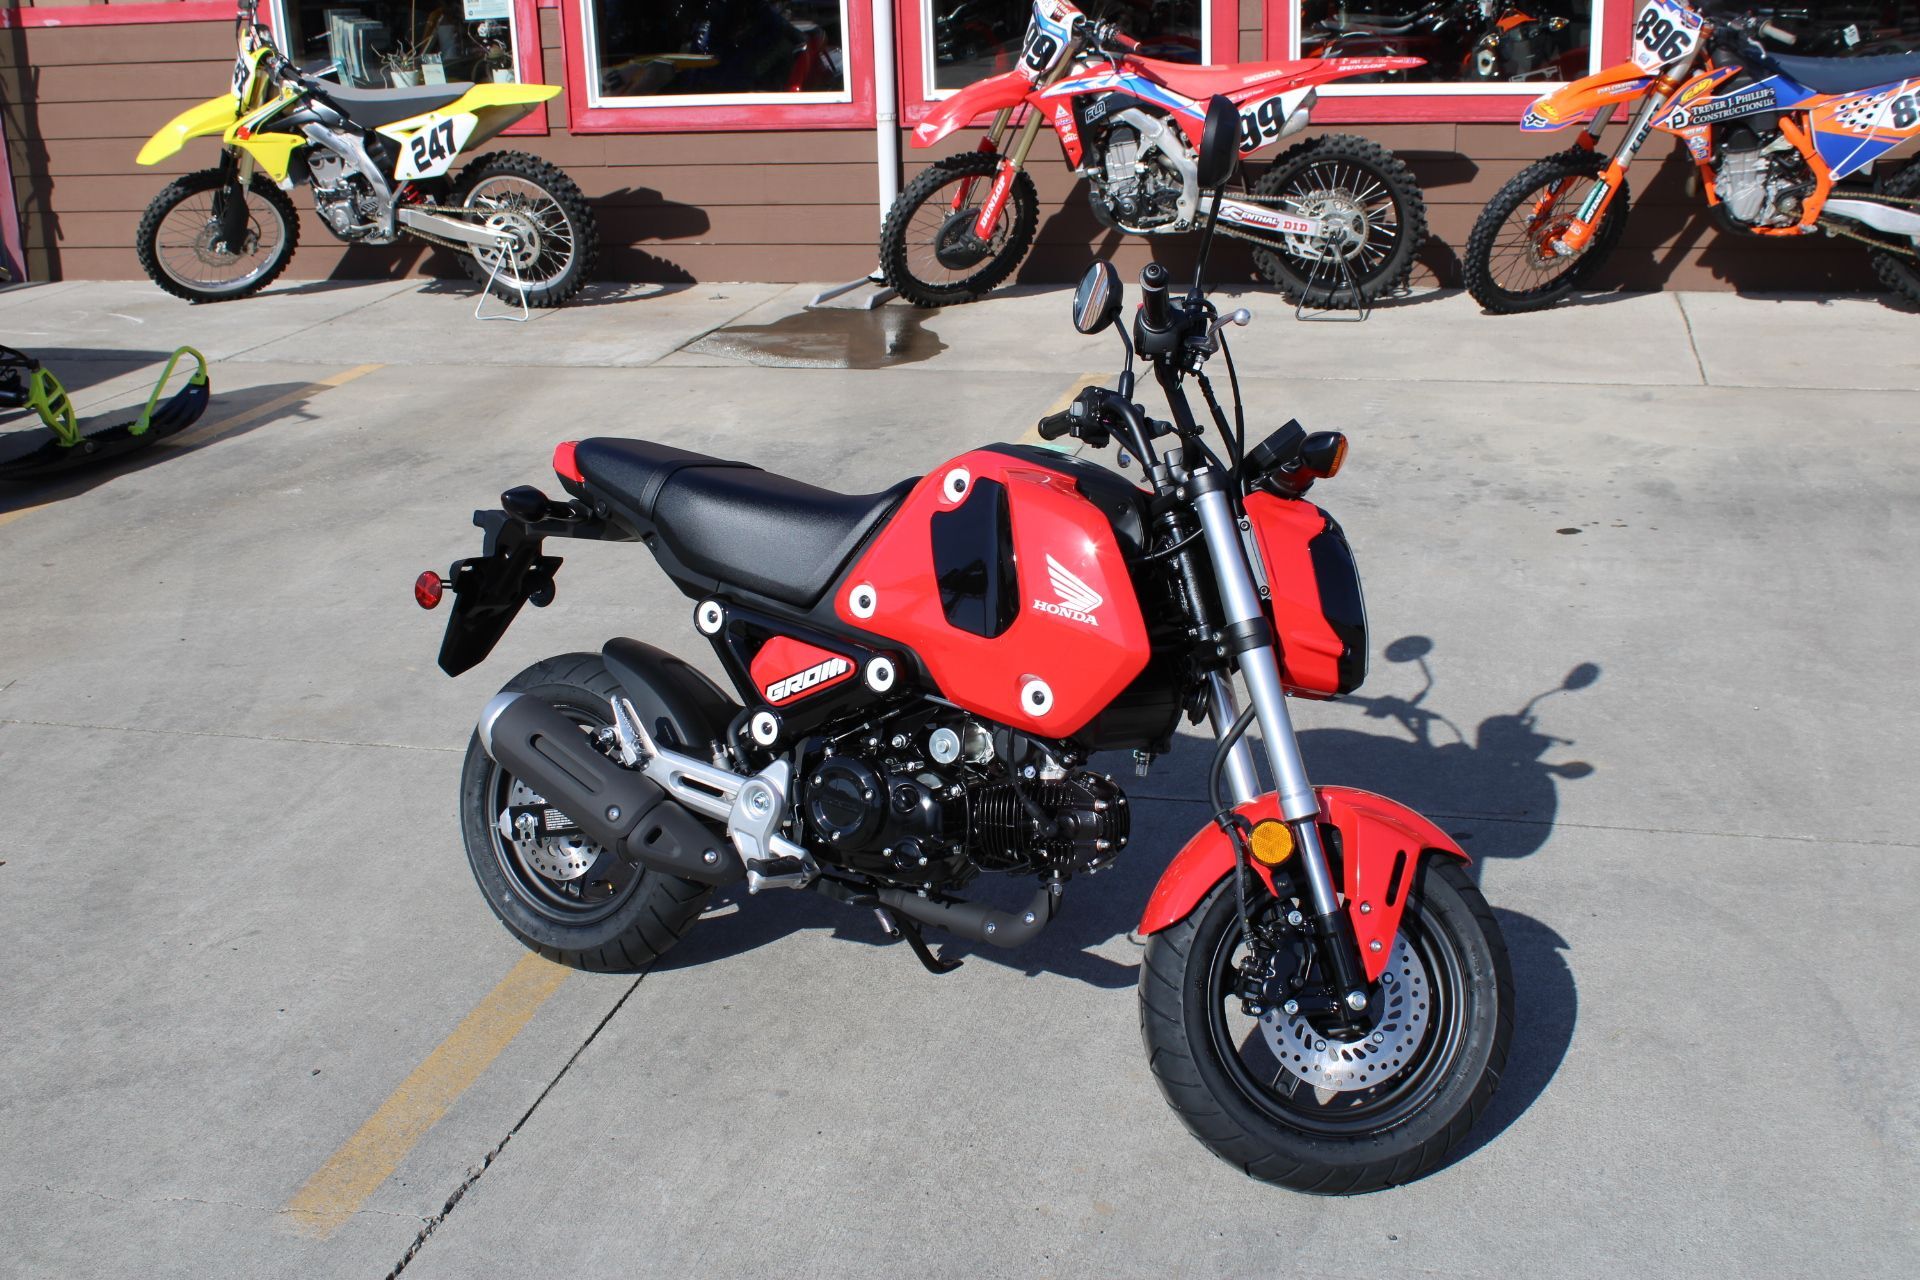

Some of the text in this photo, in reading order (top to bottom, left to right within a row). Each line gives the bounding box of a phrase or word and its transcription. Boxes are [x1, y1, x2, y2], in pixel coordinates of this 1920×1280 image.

[1635, 8, 1692, 62] 896
[1692, 99, 1727, 116] TREVER
[1735, 88, 1775, 104] PHILLIPS
[1692, 101, 1763, 125] CONSTRUCTION
[1891, 90, 1920, 129] 8
[411, 118, 457, 173] 247
[980, 175, 1006, 229] DUNLOP
[1283, 220, 1308, 232] DID
[1033, 599, 1099, 627] HONDA
[766, 657, 847, 702] GROM
